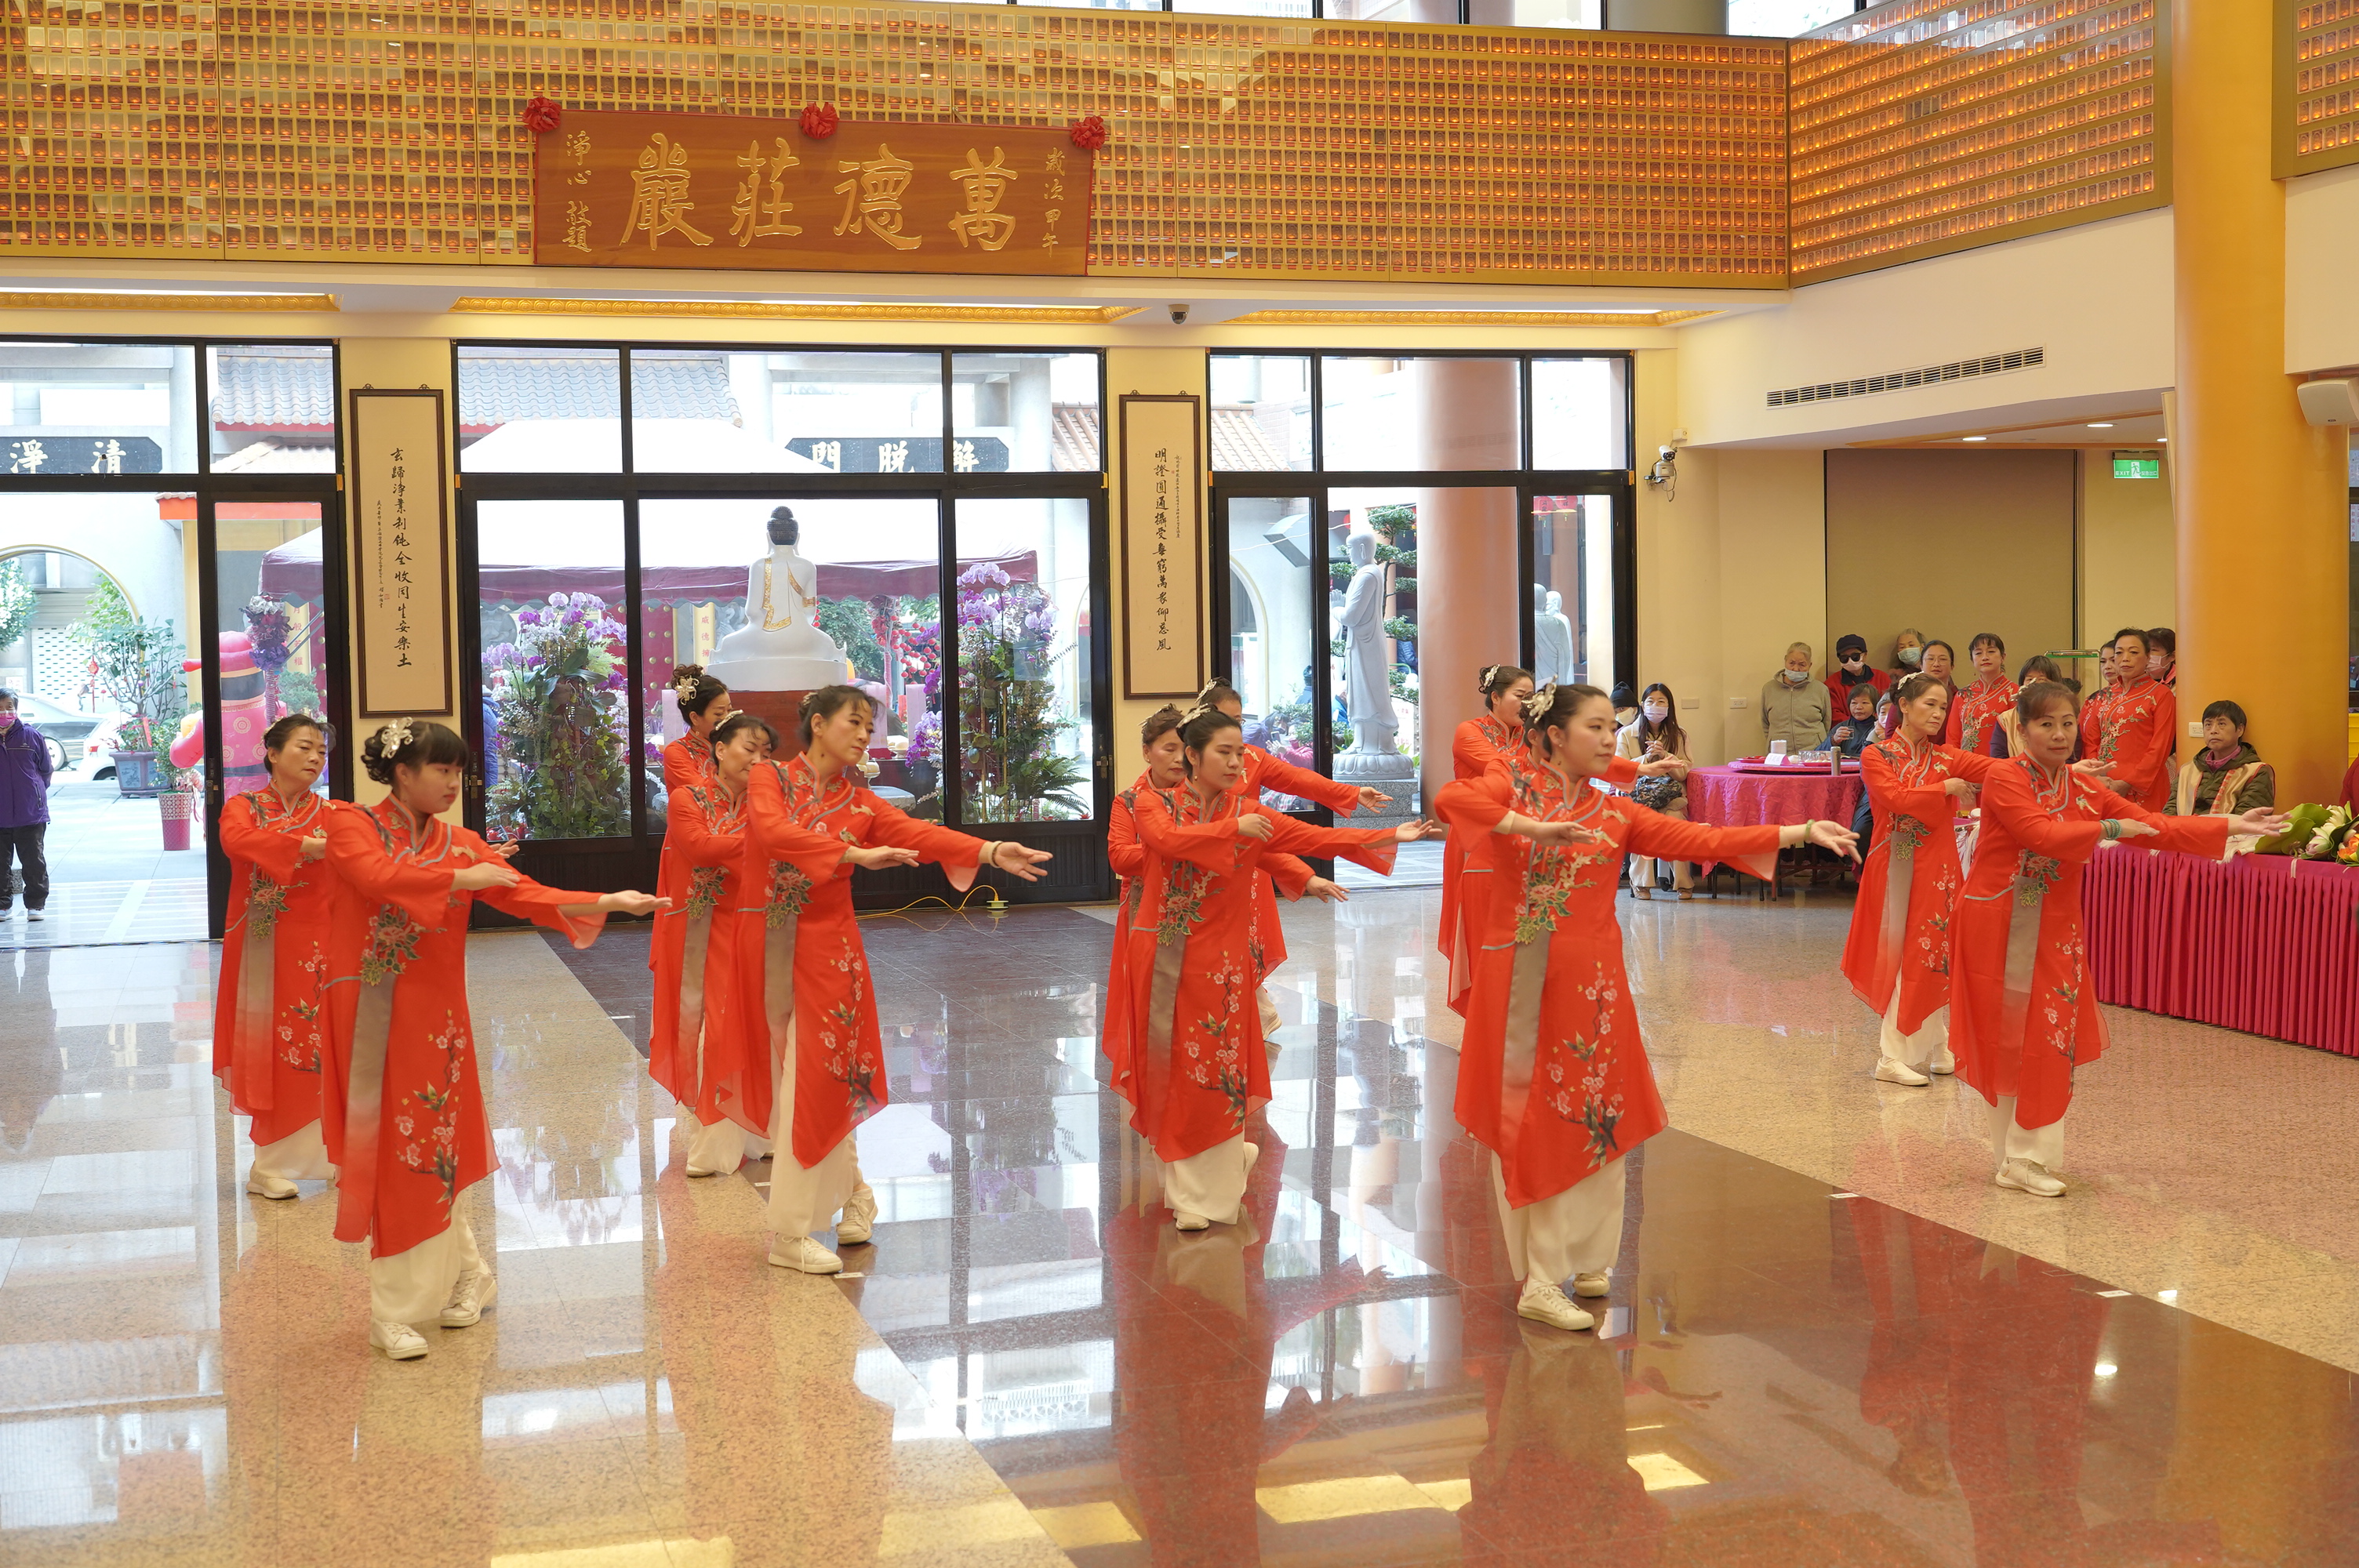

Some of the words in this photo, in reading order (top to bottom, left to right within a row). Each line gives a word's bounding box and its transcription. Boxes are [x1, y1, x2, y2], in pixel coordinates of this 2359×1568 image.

[619, 132, 1019, 251] 萬德莊嚴
[1041, 147, 1066, 258] 歲次甲午
